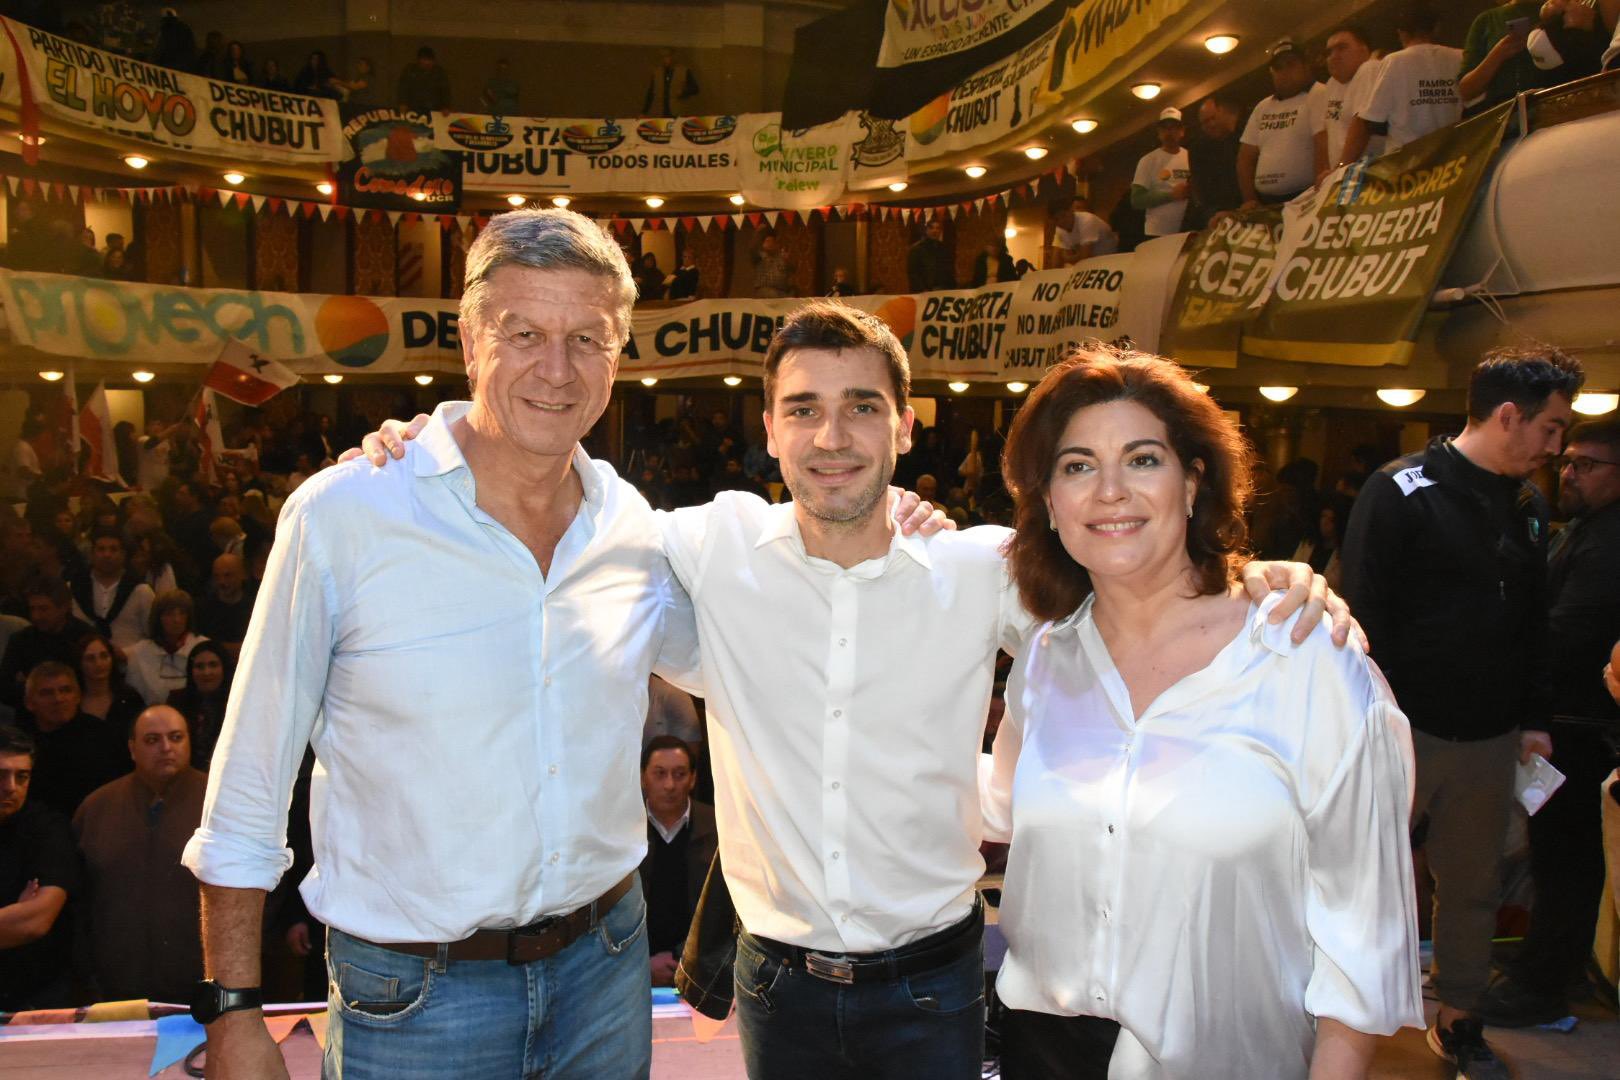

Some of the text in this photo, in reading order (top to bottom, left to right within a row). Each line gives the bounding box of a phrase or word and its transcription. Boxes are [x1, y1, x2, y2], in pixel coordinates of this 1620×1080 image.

[29, 27, 187, 95] PARTIDO VECINAL
[46, 58, 87, 112] EL
[208, 81, 324, 118] DESPIERTA
[210, 107, 325, 151] CHUBUT
[461, 148, 572, 176] HUBUT
[588, 155, 648, 169] TODOS
[653, 153, 730, 169] IGUALES
[1298, 196, 1445, 251] DESPIERTA
[1032, 283, 1060, 302] NO
[1276, 245, 1430, 302] CHUBUT
[921, 322, 1007, 360] CHUBUT
[1017, 314, 1035, 335] NO
